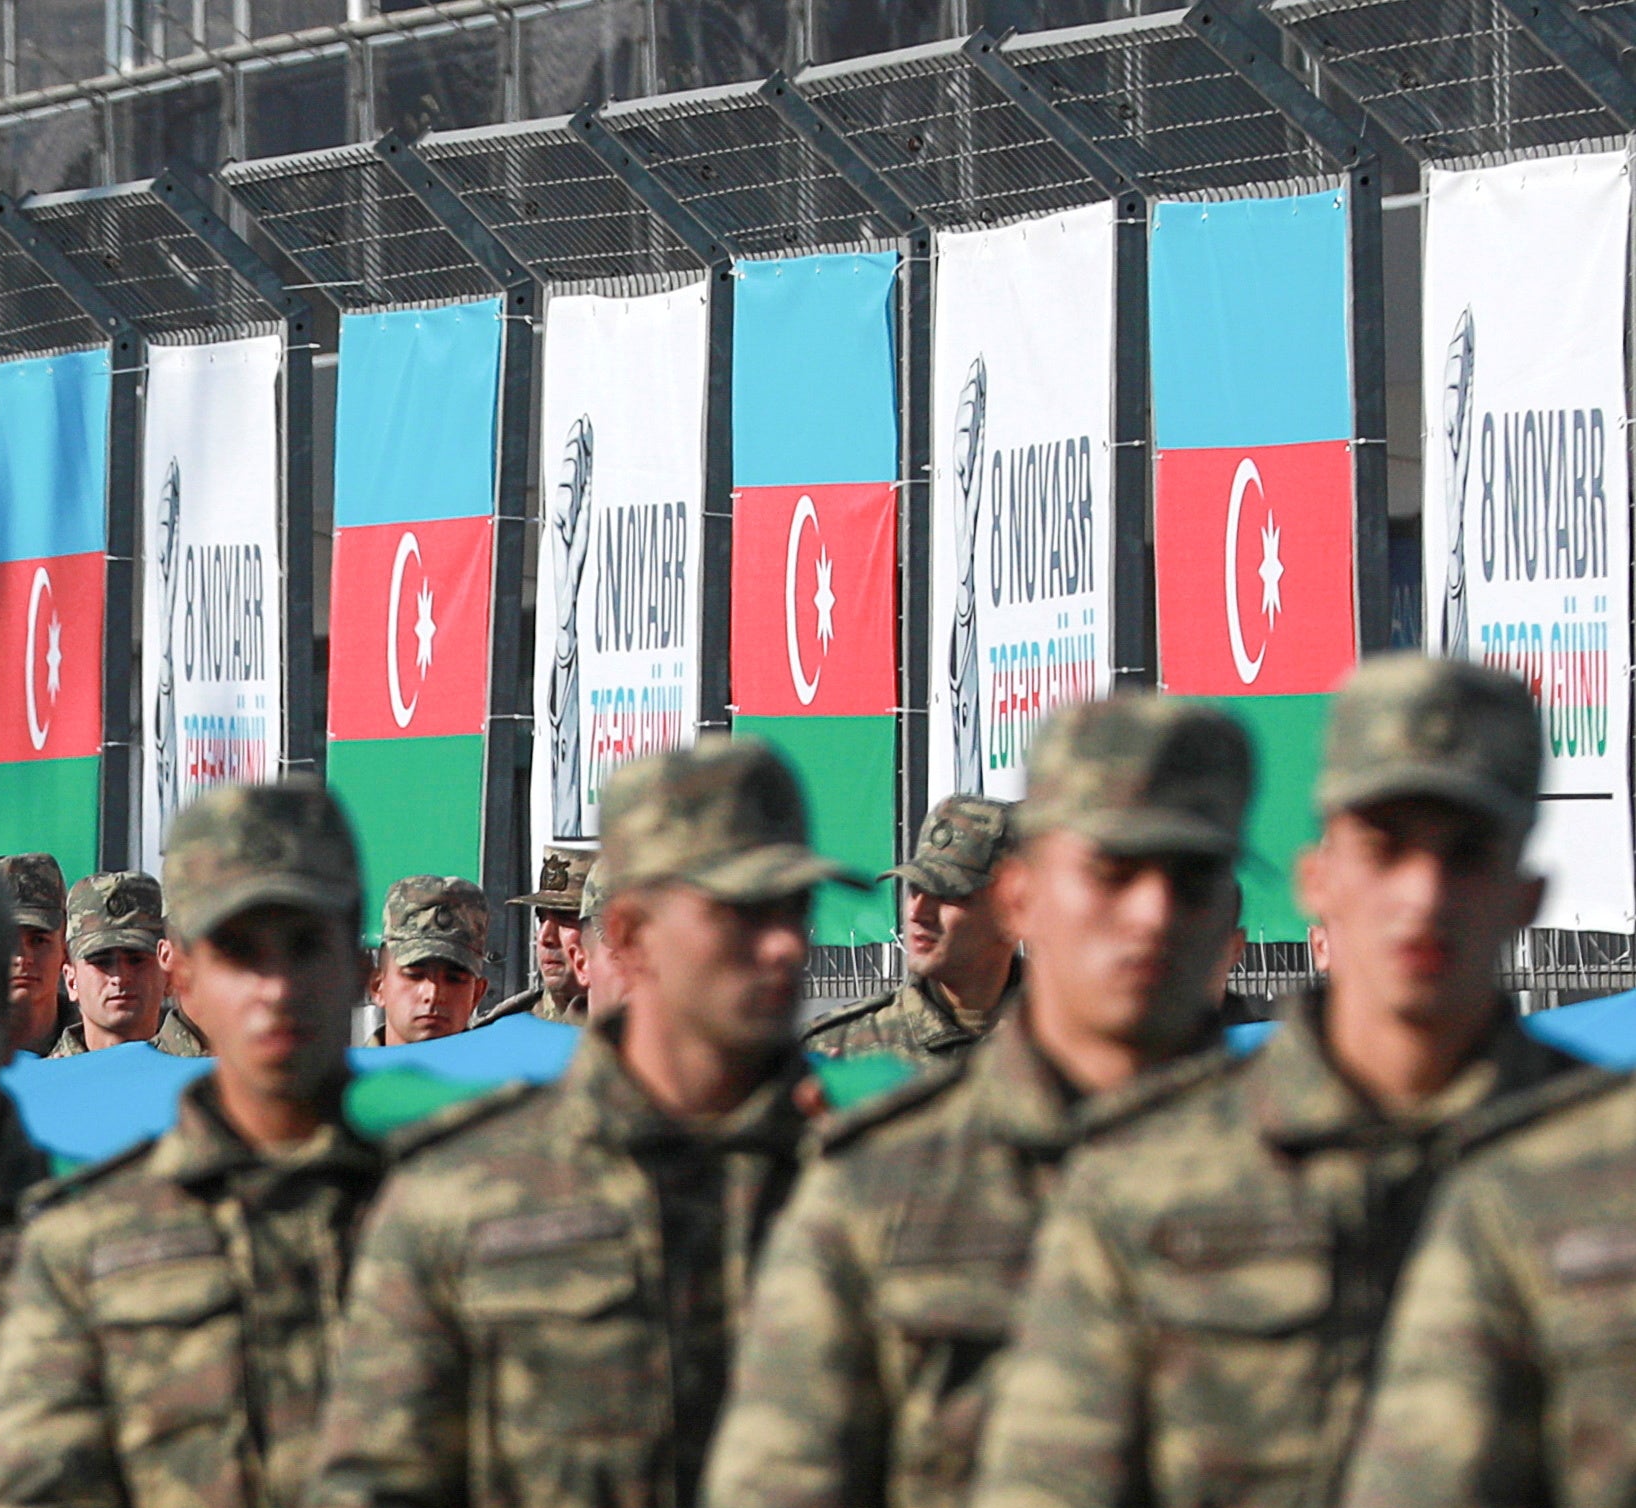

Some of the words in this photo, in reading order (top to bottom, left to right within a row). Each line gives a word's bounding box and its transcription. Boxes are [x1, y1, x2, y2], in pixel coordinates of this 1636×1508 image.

[605, 501, 686, 652] NOYABR
[991, 450, 1003, 608] 8
[1010, 435, 1095, 605] NOYABR
[1482, 411, 1495, 582] 8
[1505, 408, 1608, 582] NOYABR
[185, 544, 195, 682] 8
[200, 543, 266, 682] NOYABR
[1550, 595, 1608, 758] GÜNÜ
